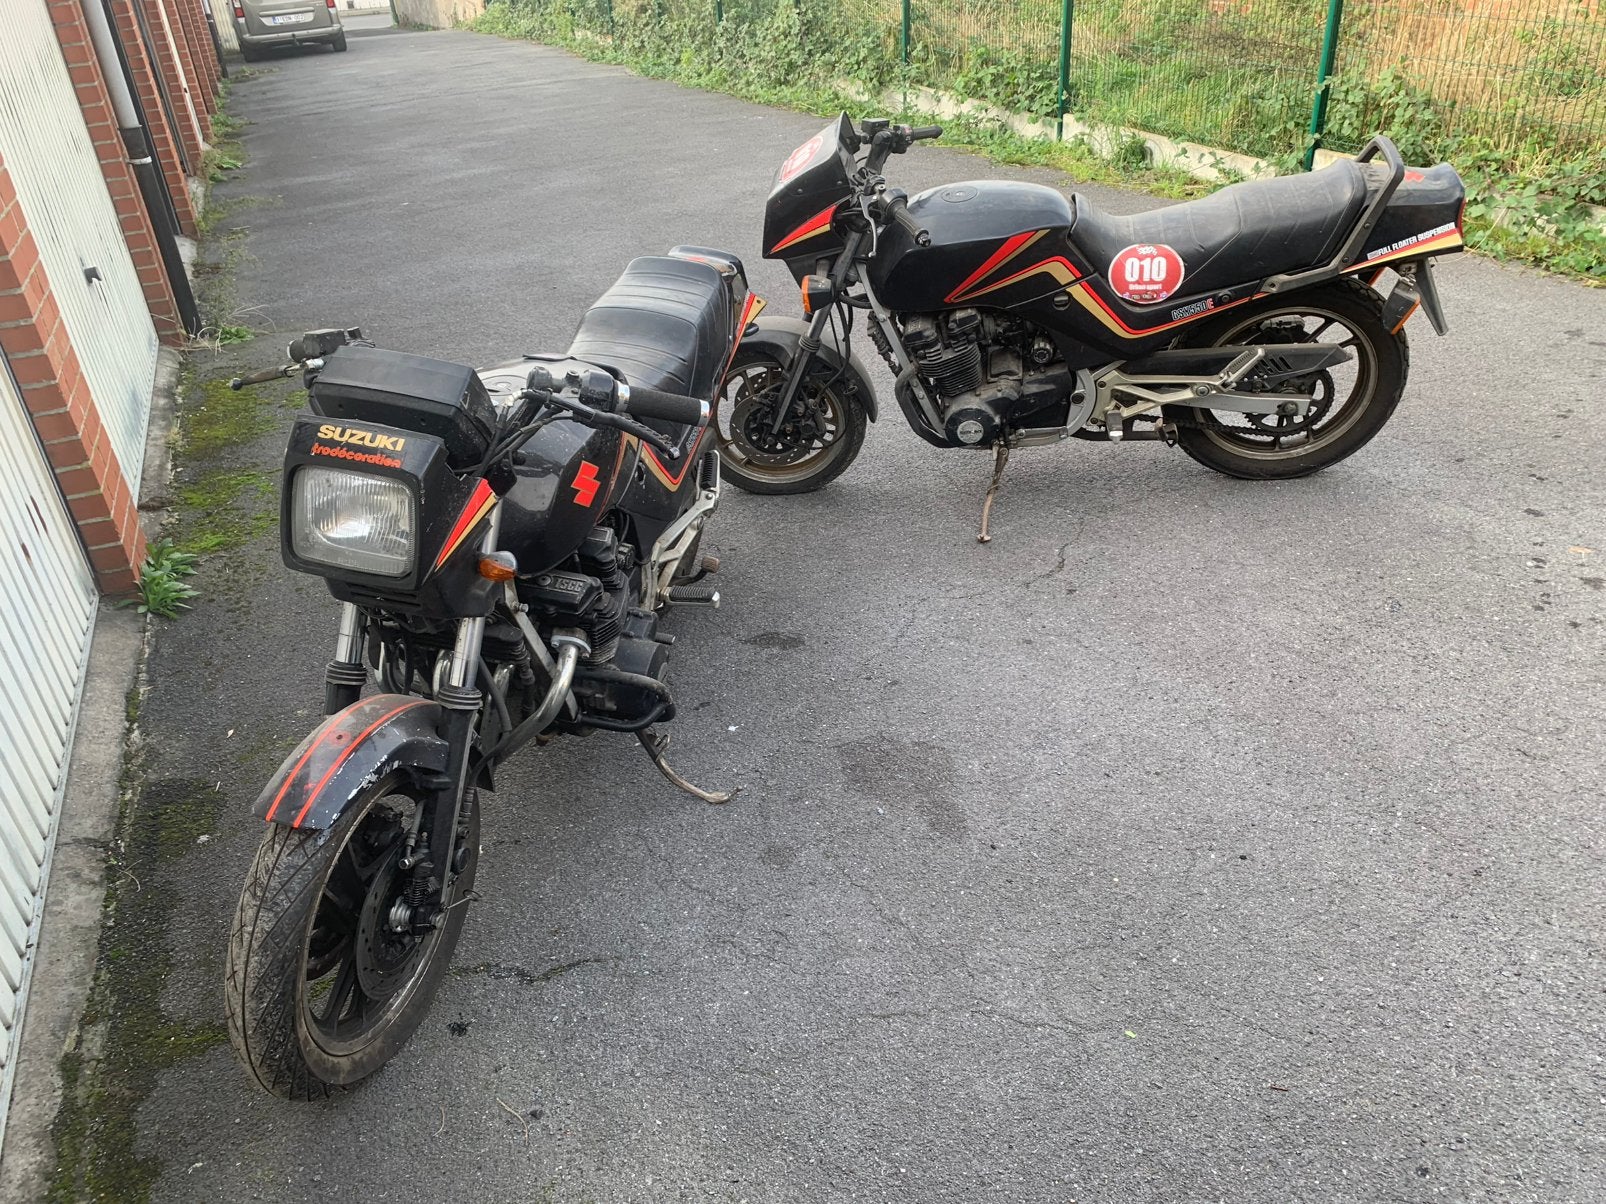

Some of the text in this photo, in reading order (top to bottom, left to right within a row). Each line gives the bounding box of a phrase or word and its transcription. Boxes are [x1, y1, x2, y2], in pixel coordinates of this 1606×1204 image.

[1377, 221, 1457, 256] FULL FLOATER SUSPENSION
[1125, 256, 1167, 282] 010
[317, 424, 405, 452] SUZUKI
